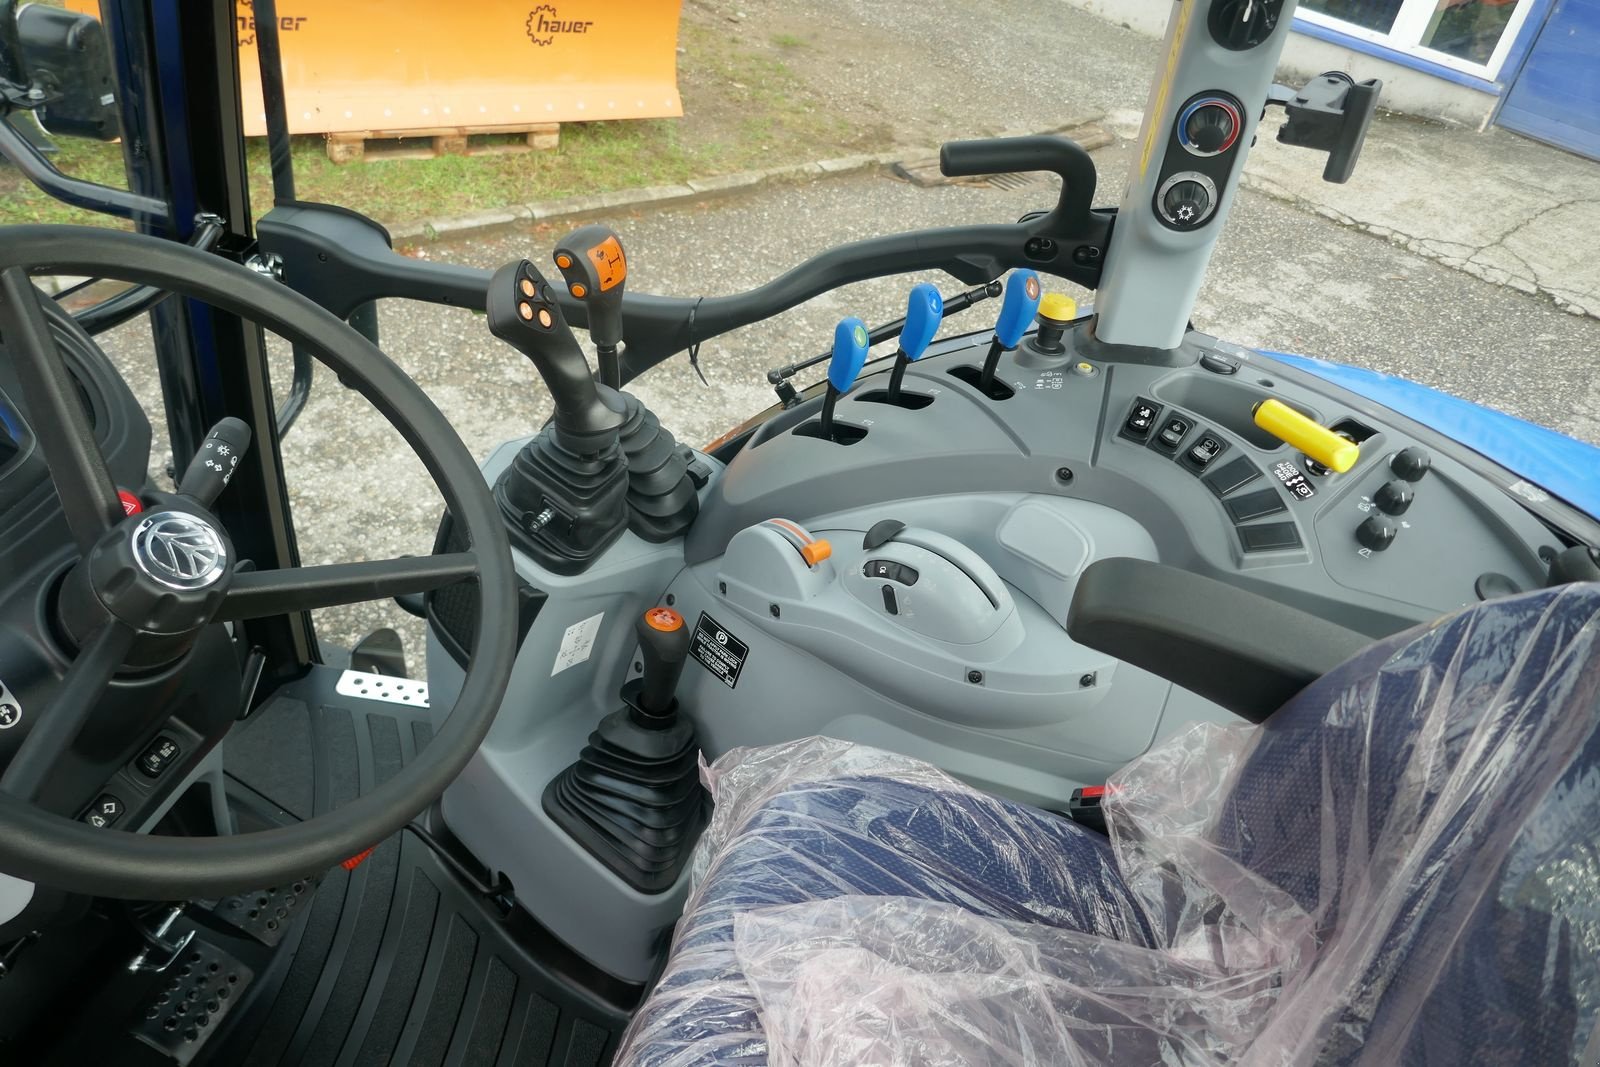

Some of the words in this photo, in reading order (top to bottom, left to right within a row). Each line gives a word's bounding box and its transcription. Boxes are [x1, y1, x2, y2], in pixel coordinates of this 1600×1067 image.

[537, 14, 593, 33] hauer
[1274, 470, 1287, 480] 540
[1284, 462, 1299, 476] 1000
